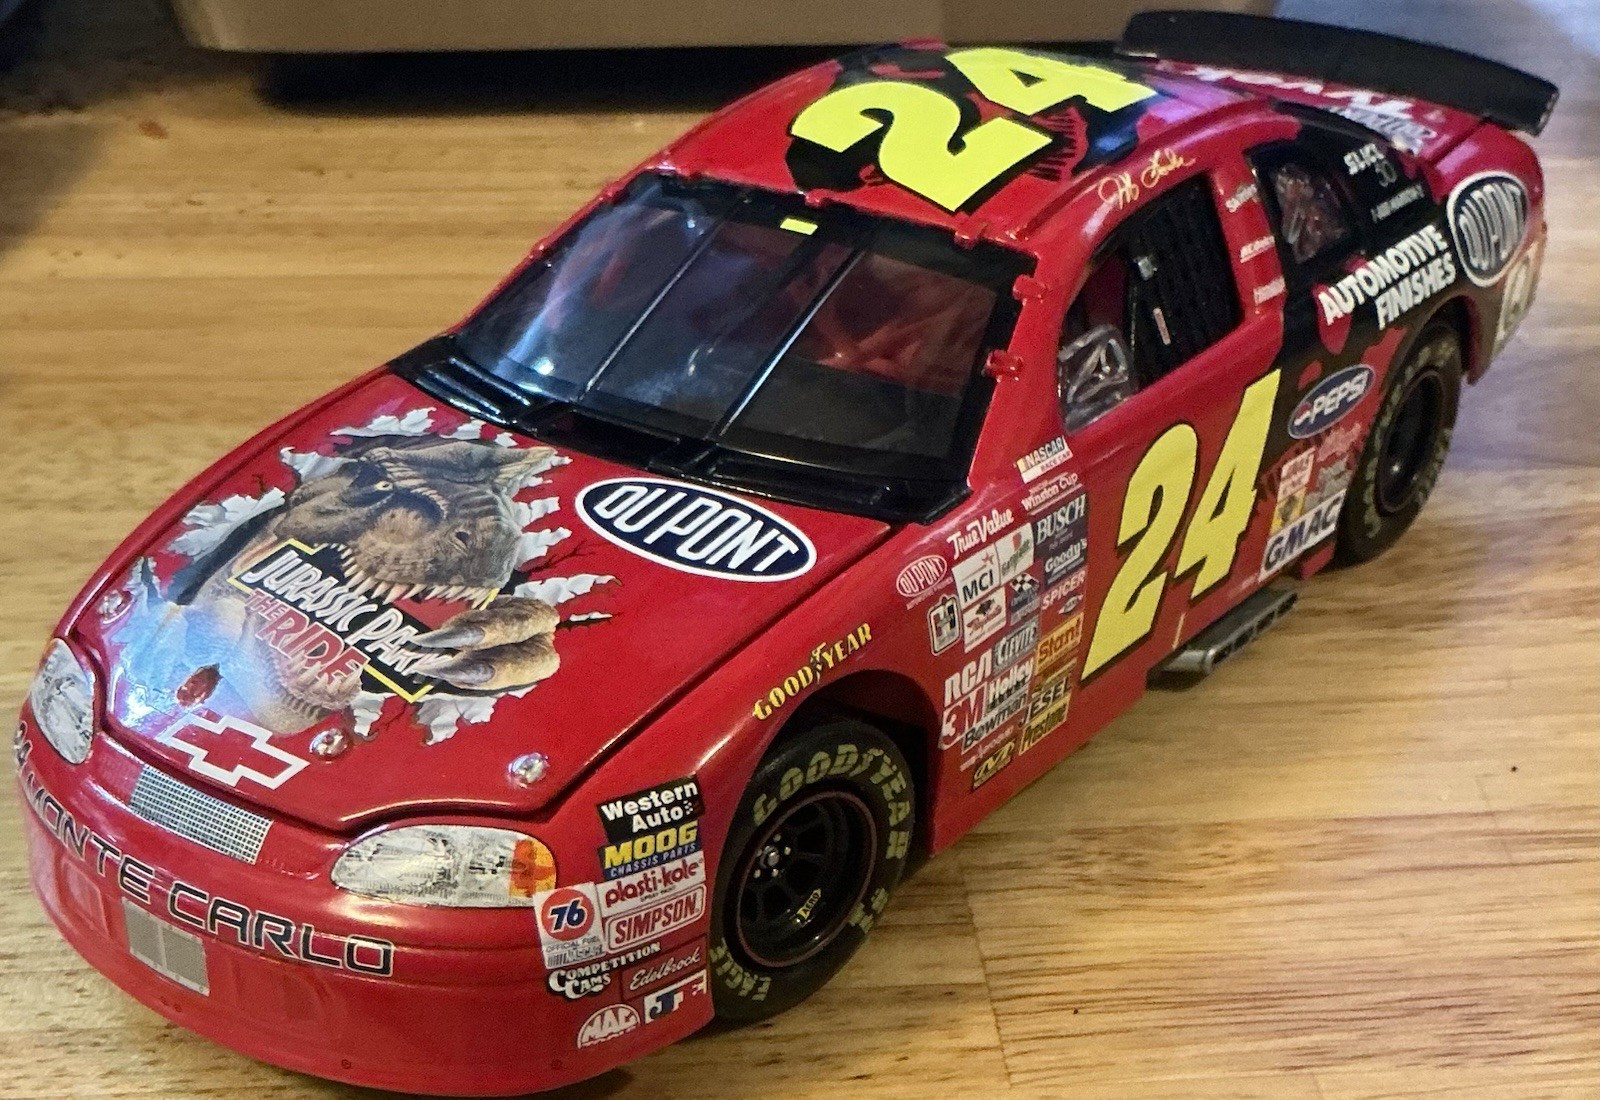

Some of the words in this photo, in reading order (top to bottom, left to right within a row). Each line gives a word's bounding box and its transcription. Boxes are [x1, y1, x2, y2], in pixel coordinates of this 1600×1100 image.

[791, 47, 1159, 212] 24
[1318, 224, 1448, 326] AUTOMOTIVE
[1375, 252, 1457, 330] FINISHES
[1309, 369, 1370, 425] PEPSI
[1025, 437, 1064, 468] NASCAR
[1021, 484, 1060, 511] Winston
[1060, 473, 1078, 490] Cup
[1036, 494, 1086, 545] BUSCH
[1080, 368, 1280, 681] 24
[1263, 493, 1342, 571] GMAC
[1044, 537, 1087, 573] Goody's
[241, 550, 379, 632] JURASSIC
[244, 587, 288, 622] THE
[962, 569, 995, 603] MCI
[1041, 570, 1086, 611] SPICER
[255, 607, 371, 685] RIDE
[944, 648, 993, 708] RCA
[601, 782, 698, 821] Western
[632, 805, 684, 833] Auto
[753, 744, 911, 860] GOODYEAR
[604, 820, 698, 869] MOOG
[610, 855, 659, 878] CHASSIS
[662, 842, 697, 862] PARTS
[167, 880, 394, 977] CARLO
[550, 898, 588, 932] 76
[615, 893, 697, 945] SIMPSON
[549, 941, 661, 992] COMPETITION
[565, 971, 611, 1000] CAMS
[630, 947, 701, 991] Edelbrock
[581, 1007, 638, 1044] MAC
